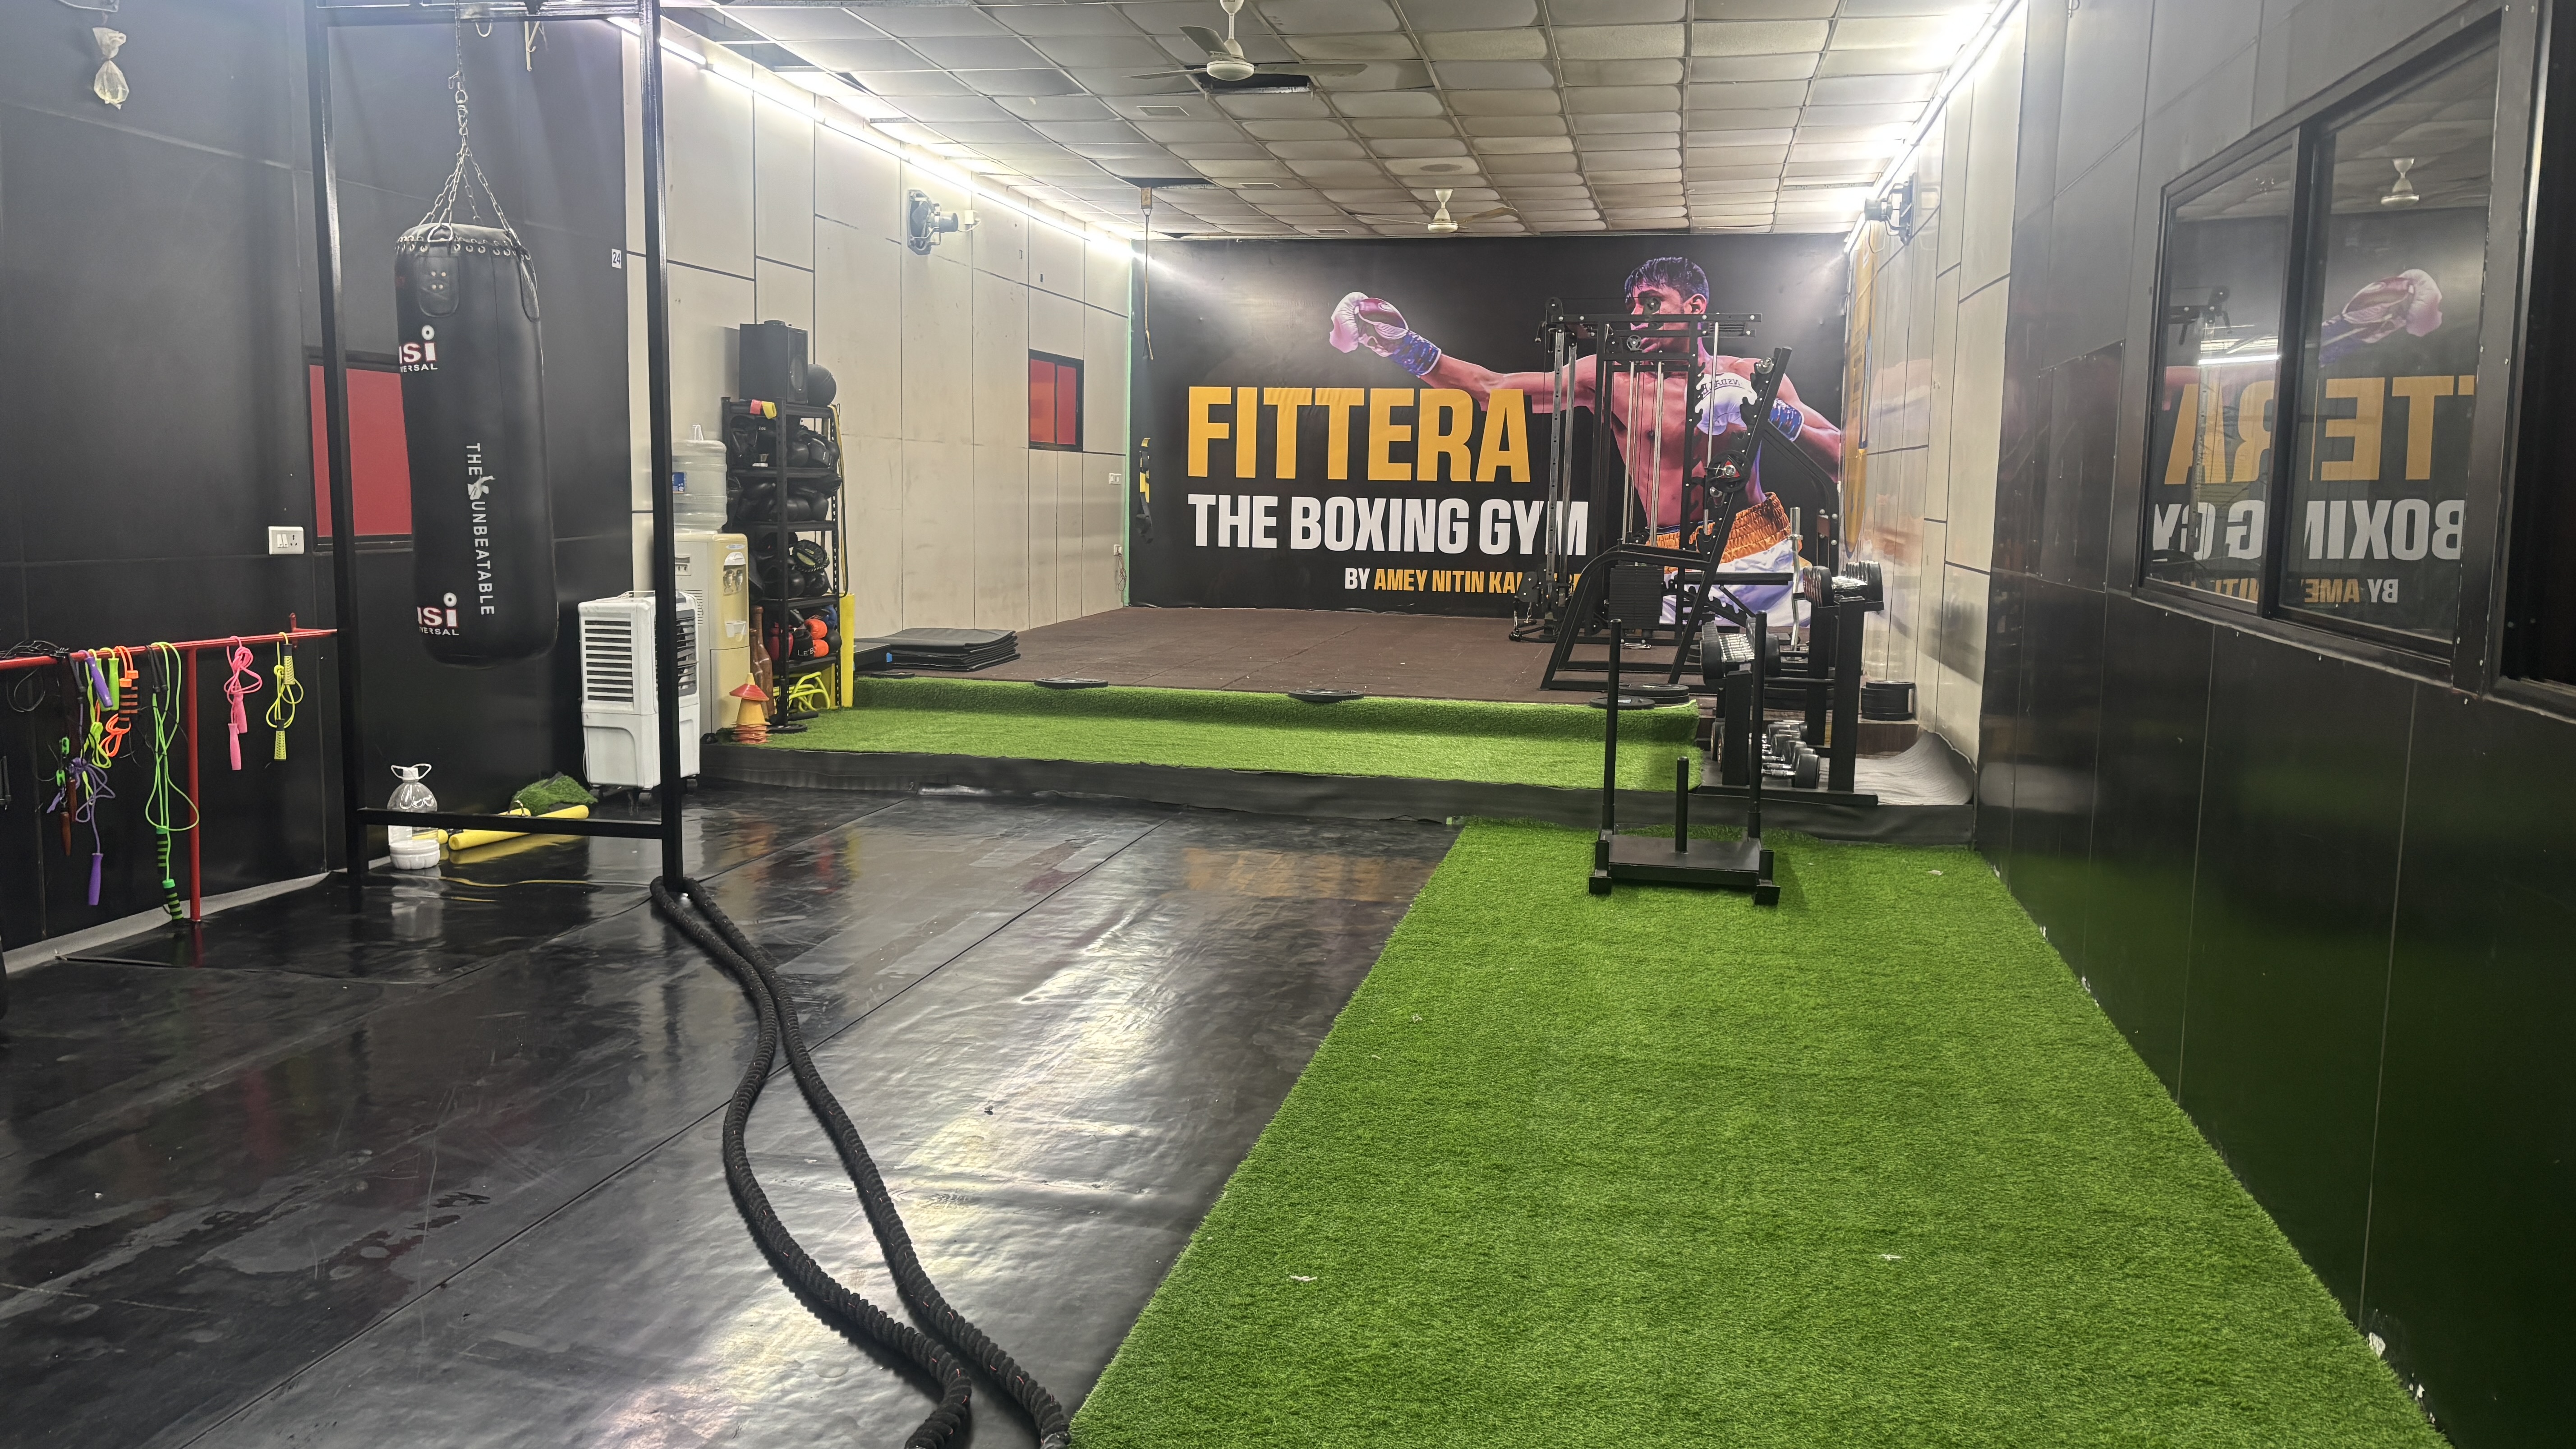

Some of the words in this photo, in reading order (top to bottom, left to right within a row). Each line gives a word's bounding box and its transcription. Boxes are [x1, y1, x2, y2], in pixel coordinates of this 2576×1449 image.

[613, 251, 621, 265] 24
[1188, 386, 1530, 482] FITTERA
[466, 443, 483, 475] THE
[1188, 494, 1278, 548] THE
[1291, 497, 1469, 554] BOXING
[1479, 499, 1588, 556] GYM
[471, 501, 495, 615] UNBEATABLE
[1345, 568, 1370, 589] BY
[1374, 568, 1427, 591] AMEY
[1432, 570, 1484, 593] NITIN
